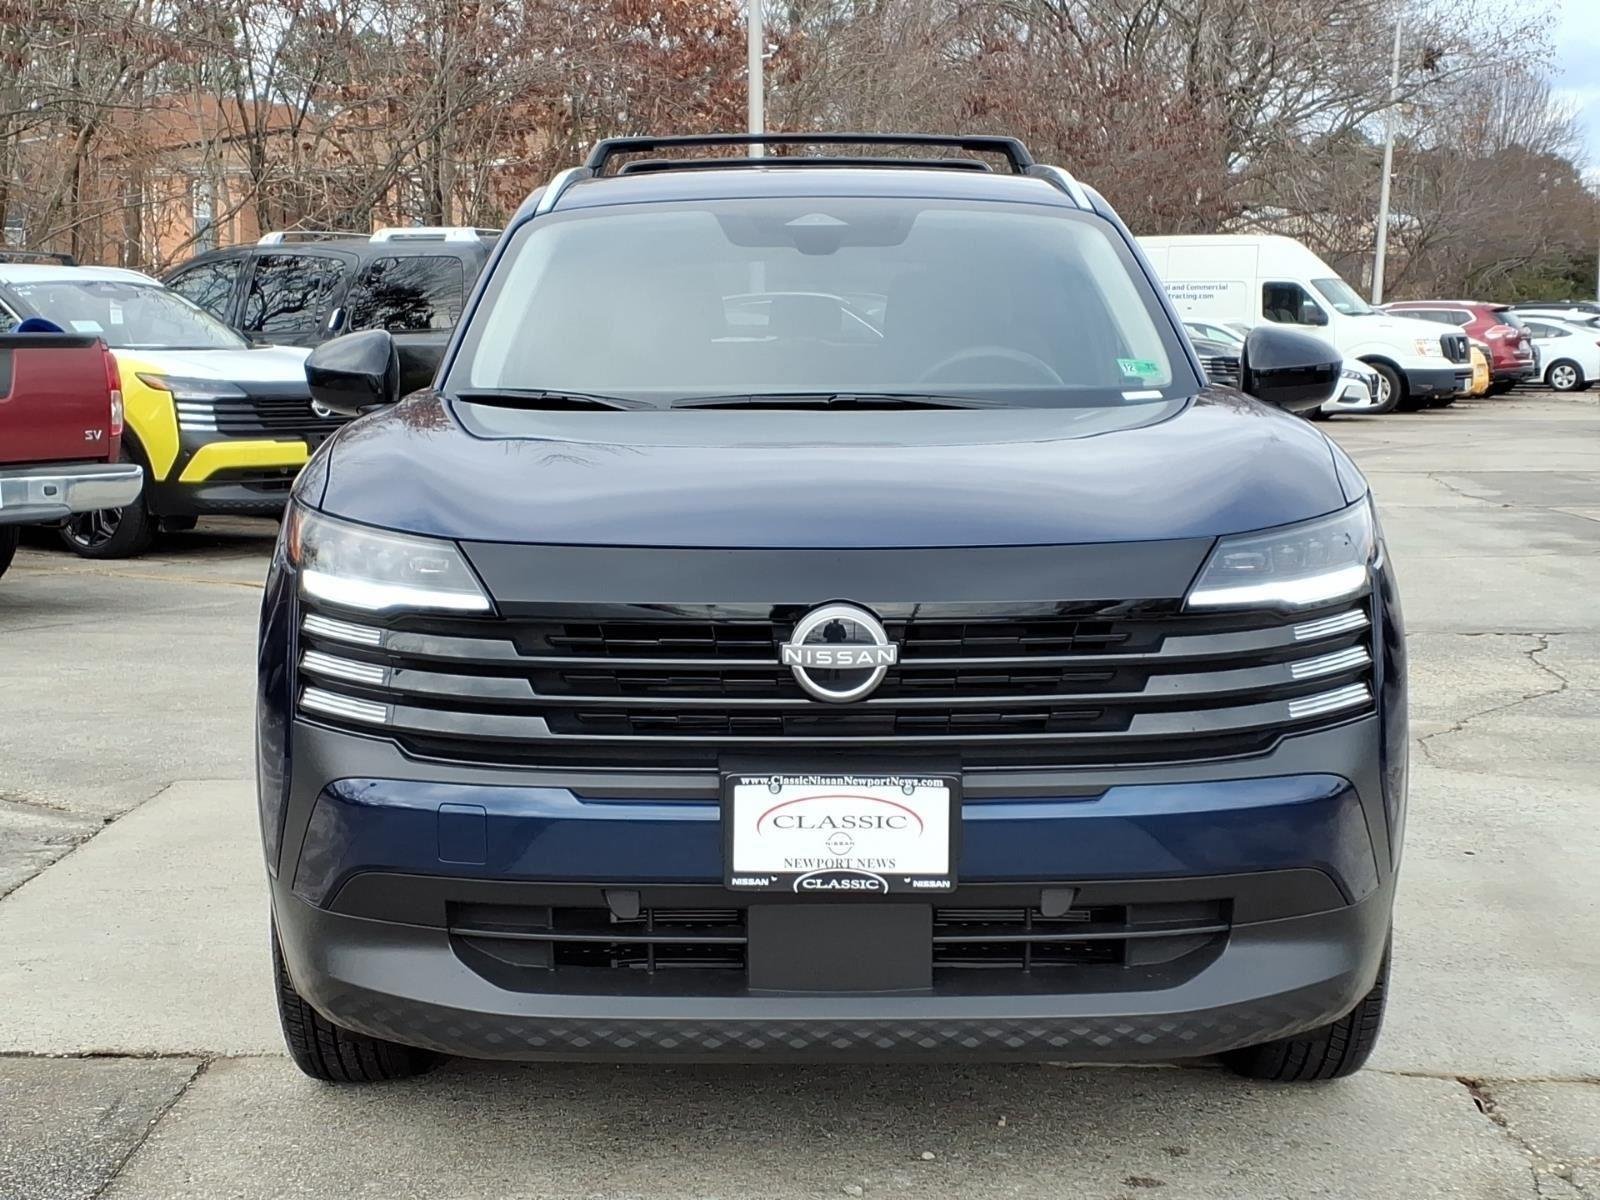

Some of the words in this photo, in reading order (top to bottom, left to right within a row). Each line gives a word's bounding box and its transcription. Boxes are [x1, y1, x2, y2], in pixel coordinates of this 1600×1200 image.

[85, 430, 102, 440] SV
[785, 648, 894, 664] NISSAN
[740, 775, 944, 787] www.ClassicNissanNewportNews.com
[773, 815, 907, 829] CLASSIC
[784, 858, 853, 869] NEWPORT
[857, 858, 896, 869] NEWS
[731, 877, 769, 886] NISSAN
[802, 879, 880, 889] CLASSIC
[913, 880, 951, 888] NISSAN
